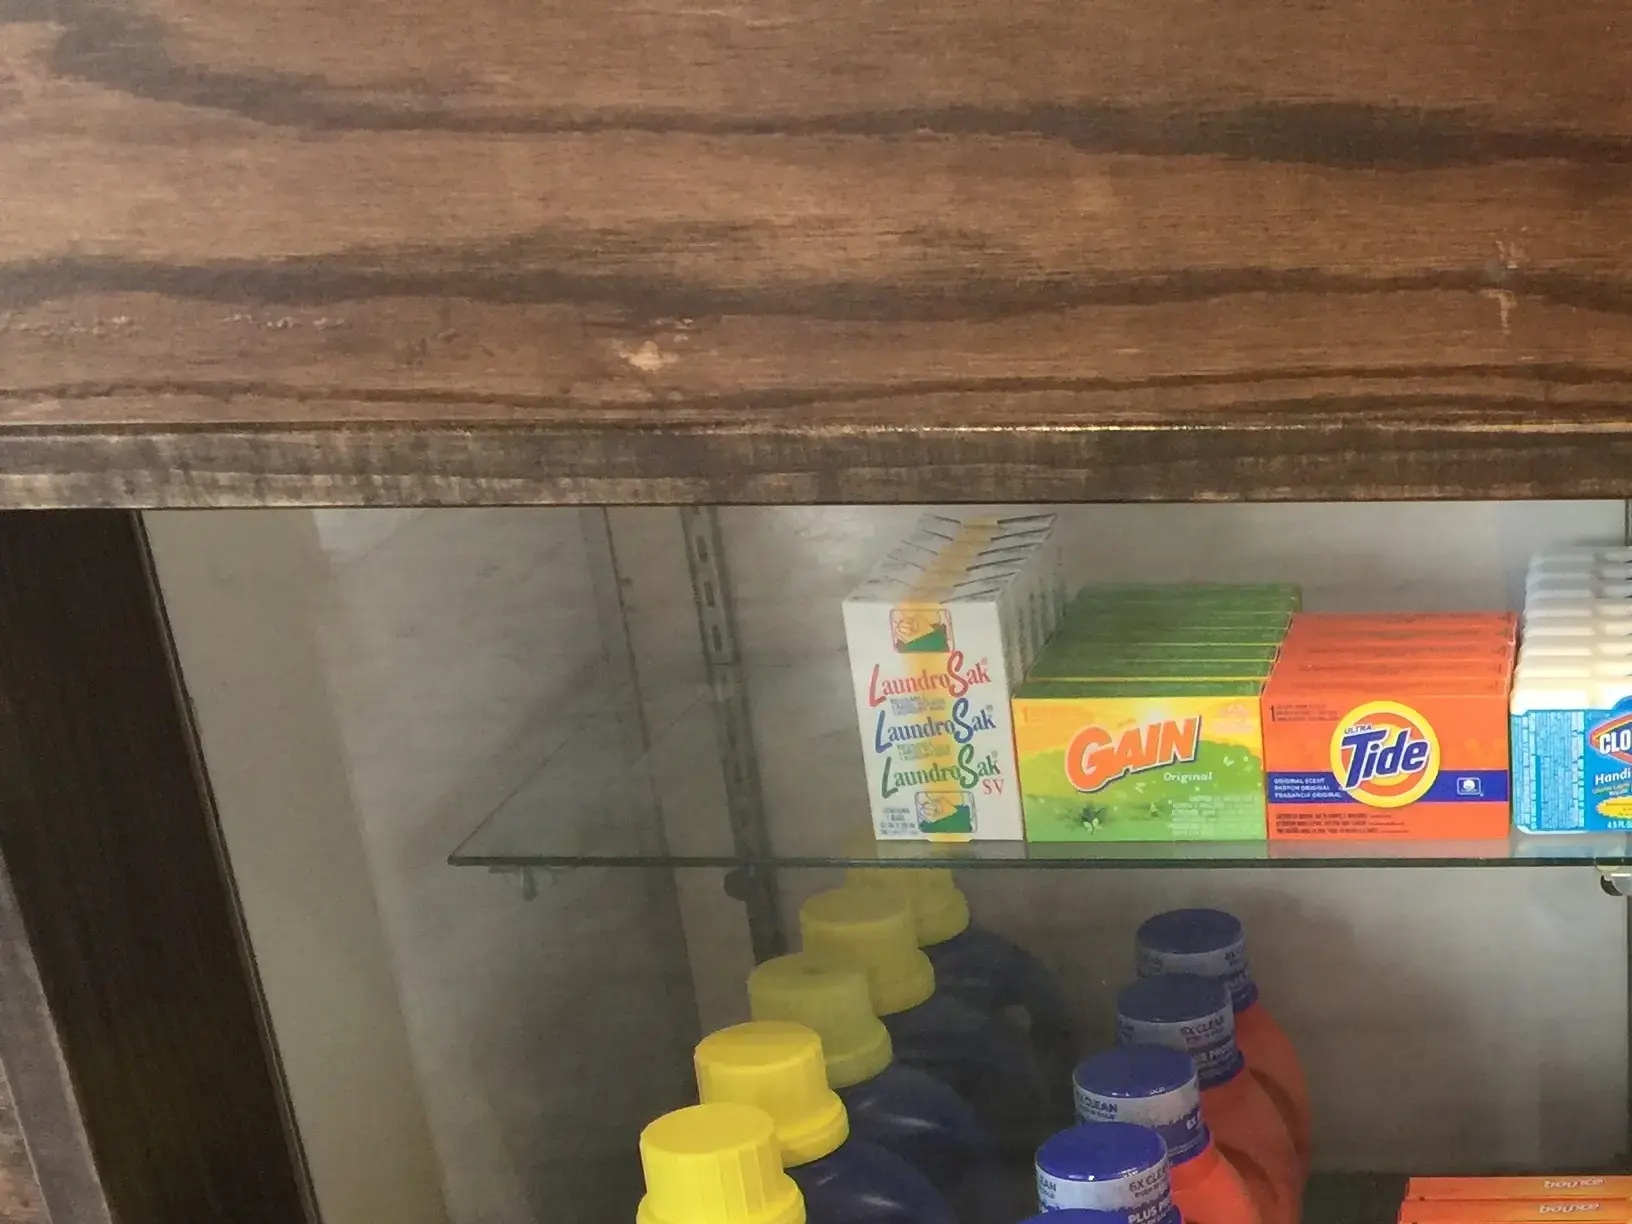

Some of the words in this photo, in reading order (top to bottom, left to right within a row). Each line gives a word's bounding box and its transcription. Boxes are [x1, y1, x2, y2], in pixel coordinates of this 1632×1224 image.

[868, 650, 991, 707] LaundroSak
[1270, 705, 1276, 722] 1
[875, 697, 996, 753] LaundroSak
[1344, 724, 1372, 735] ULTRA
[1065, 715, 1203, 794] GAIN
[1341, 728, 1430, 790] Tide
[881, 743, 1002, 799] LaundroSak
[1164, 772, 1213, 784] Original
[981, 778, 1005, 795] SV
[1544, 1178, 1604, 1189] bounce
[1540, 1203, 1600, 1214] bounce
